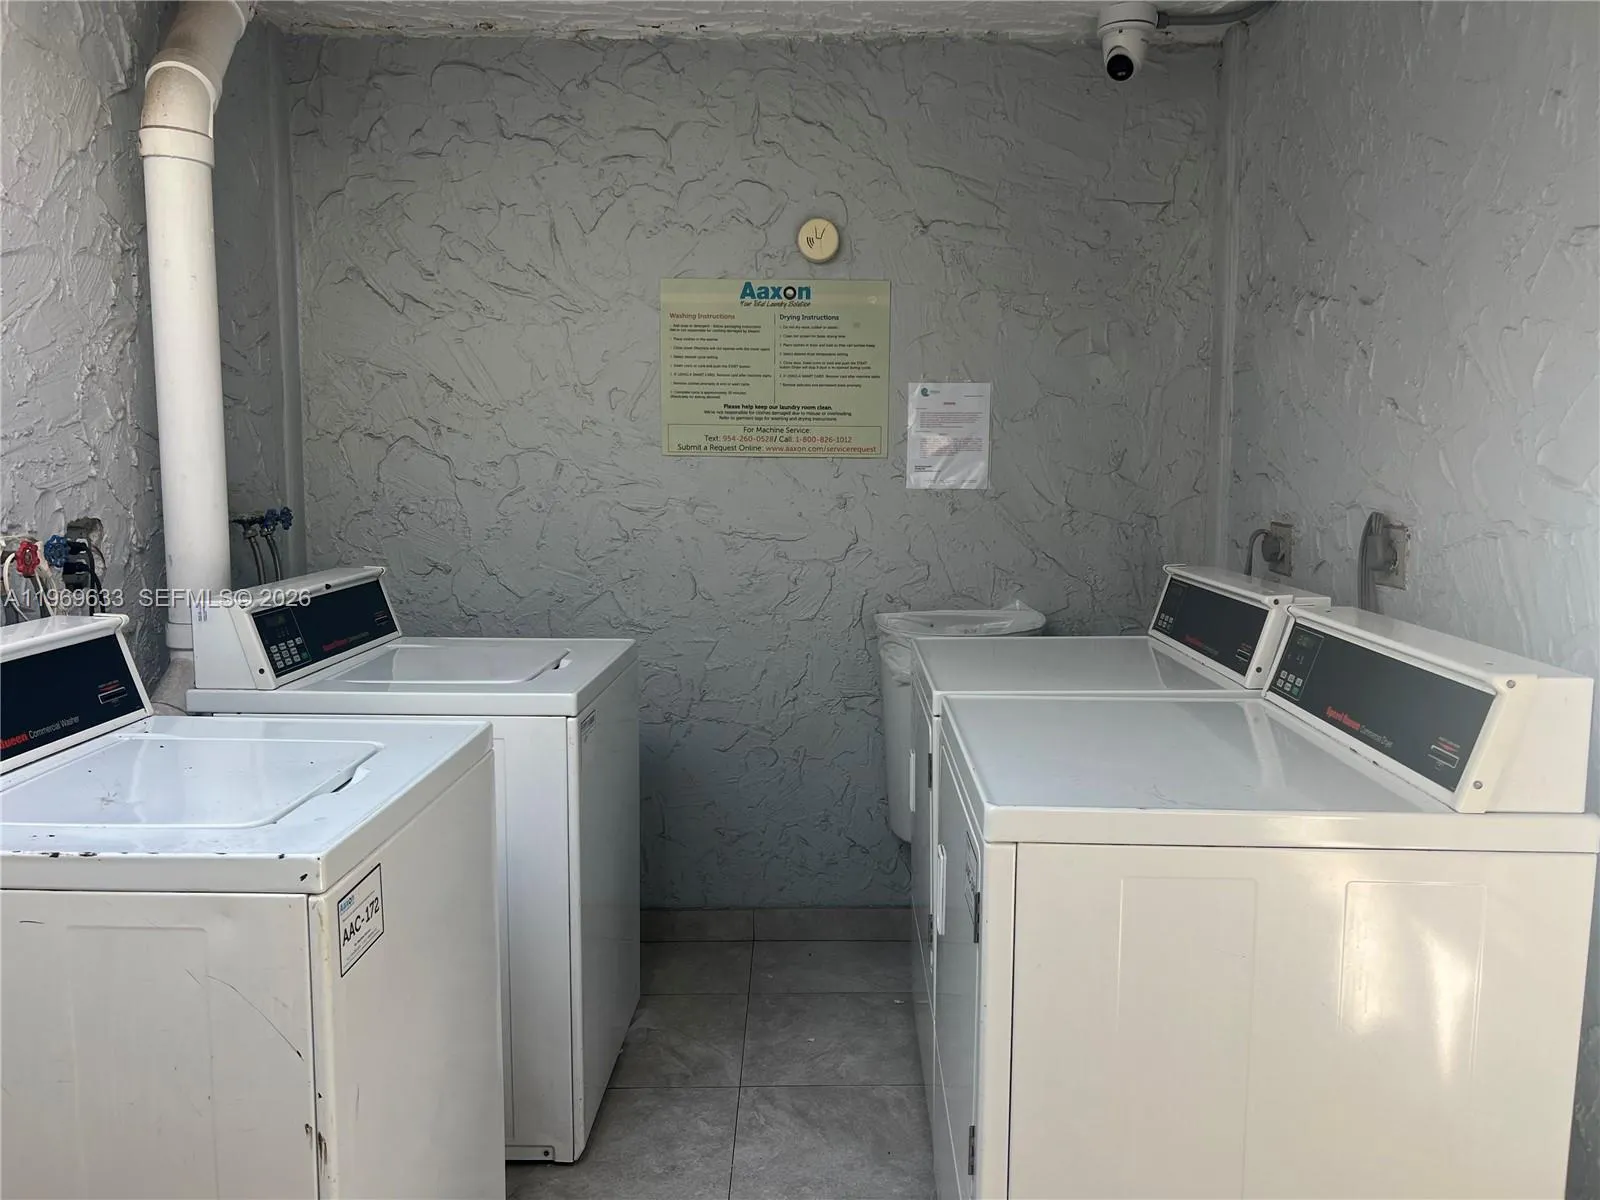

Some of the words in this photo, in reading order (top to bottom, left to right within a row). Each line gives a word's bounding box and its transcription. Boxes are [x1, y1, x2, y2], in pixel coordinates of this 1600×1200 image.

[740, 281, 811, 300] Aaxon
[669, 312, 697, 321] Washing
[779, 314, 801, 322] Drying
[743, 426, 755, 434] For
[755, 426, 784, 434] Machine
[796, 436, 852, 444] 1-800-826-1012
[677, 443, 702, 452] Submit
[709, 444, 738, 453] Request
[765, 445, 877, 454] www.aaxon.com/servicerequest
[28, 721, 61, 739] Commercial
[60, 716, 80, 728] Washer
[342, 896, 380, 947] AAC-172
